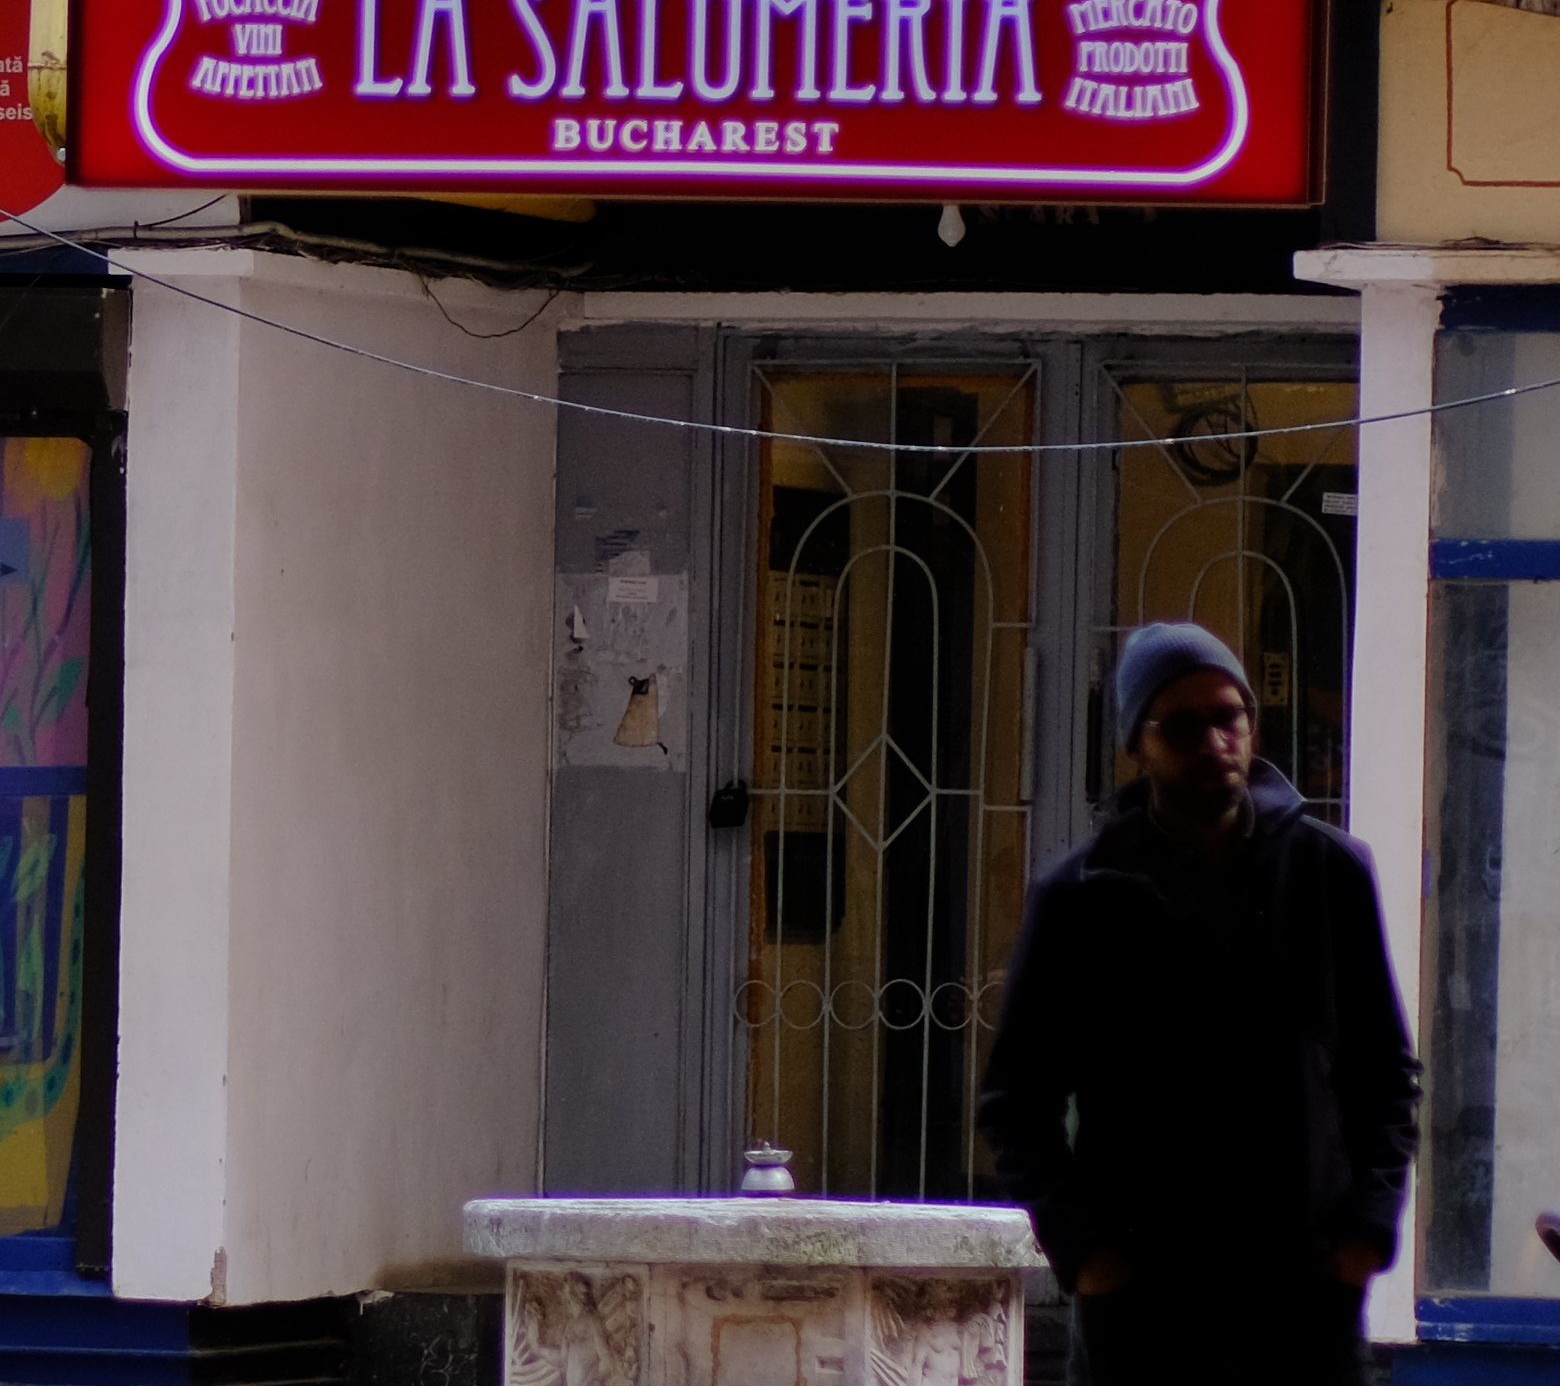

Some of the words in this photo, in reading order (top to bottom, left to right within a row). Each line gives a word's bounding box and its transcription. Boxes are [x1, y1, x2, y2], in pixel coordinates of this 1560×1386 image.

[233, 23, 283, 56] VINI
[1078, 40, 1189, 73] PRODOTTI
[192, 57, 323, 100] AFFETTATI
[1064, 76, 1200, 119] ITALIANI
[553, 118, 841, 154] BUCHAREST
